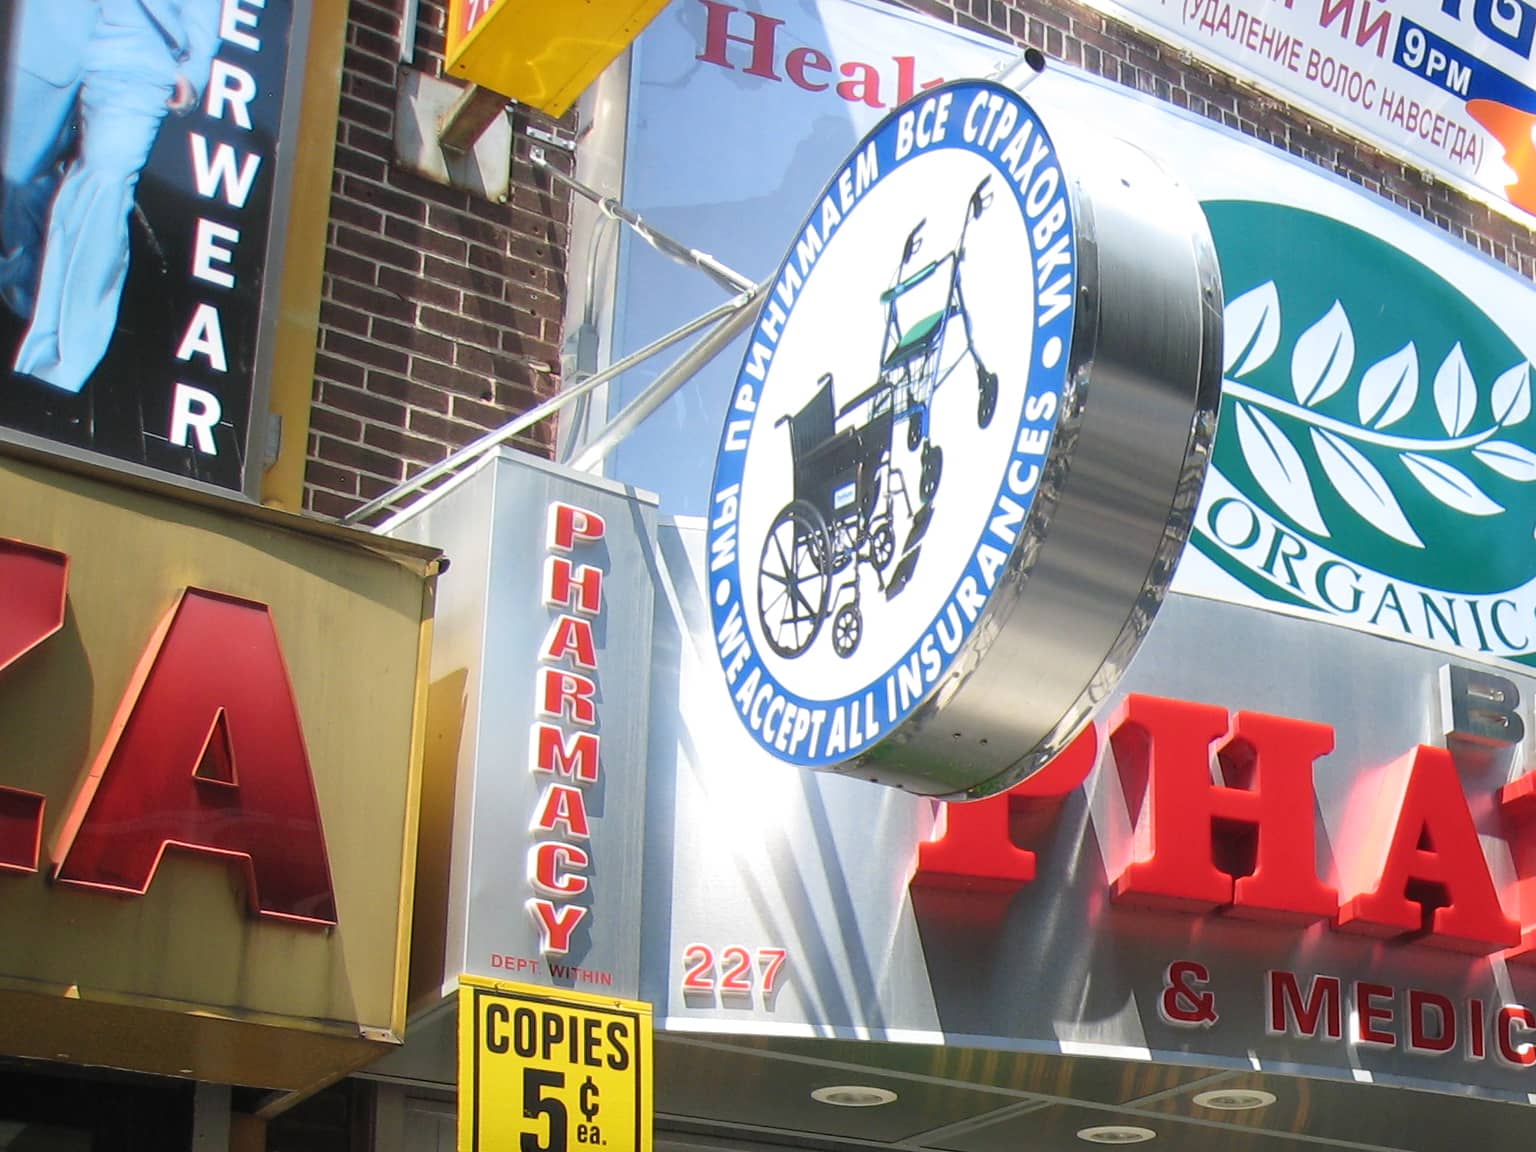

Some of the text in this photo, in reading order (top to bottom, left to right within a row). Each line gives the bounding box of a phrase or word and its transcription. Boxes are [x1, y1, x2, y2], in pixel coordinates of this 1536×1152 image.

[696, 0, 943, 111] Heal
[1402, 28, 1473, 98] 9PM
[1306, 49, 1377, 110] ВОЛОС
[1378, 88, 1485, 175] НАВСЕГДА)
[710, 90, 1074, 561] МЫ ПРИНИМАЕМ ВСЕ СТРАХОВКИ
[716, 390, 1057, 760] WE ACCEPT ALL INSURANCES
[1207, 497, 1529, 656] ORGANIC
[528, 499, 605, 956] PHARMACY
[549, 963, 613, 986] WITHIN
[682, 943, 787, 993] 227
[1163, 960, 1218, 1027] &
[486, 1003, 630, 1071] COPIES
[577, 1123, 607, 1146] ea.
